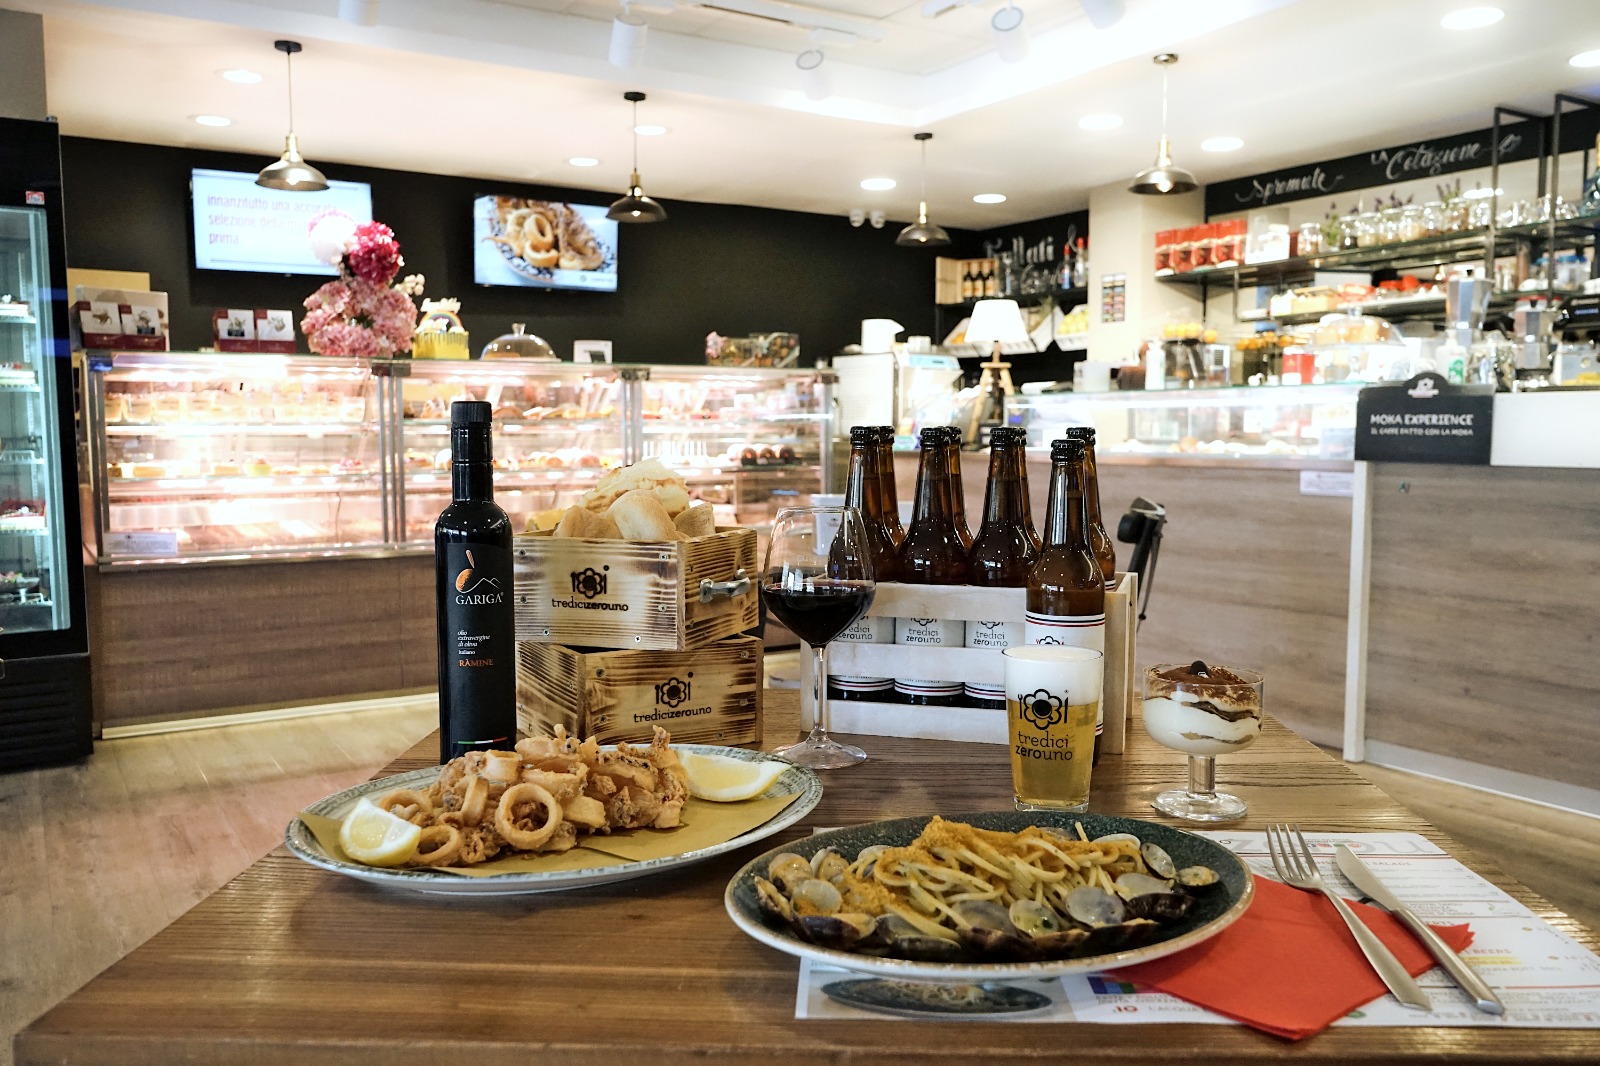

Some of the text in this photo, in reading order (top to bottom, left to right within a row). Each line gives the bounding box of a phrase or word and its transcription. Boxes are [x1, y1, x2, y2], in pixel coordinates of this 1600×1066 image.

[207, 195, 268, 209] innanzitutto
[272, 200, 290, 211] una
[208, 212, 256, 227] selezione
[209, 232, 239, 245] prima
[1370, 413, 1474, 425] MOKA EXPERIENCE
[551, 596, 629, 612] tredicizerouno
[848, 623, 870, 633] edici
[908, 625, 939, 637] tredici
[975, 628, 1005, 640] tredici
[905, 635, 942, 644] zerouno
[973, 638, 1009, 647] zerouno
[633, 706, 712, 723] tredicizerouno
[1017, 731, 1069, 749] tredici
[1015, 744, 1073, 761] zerouno
